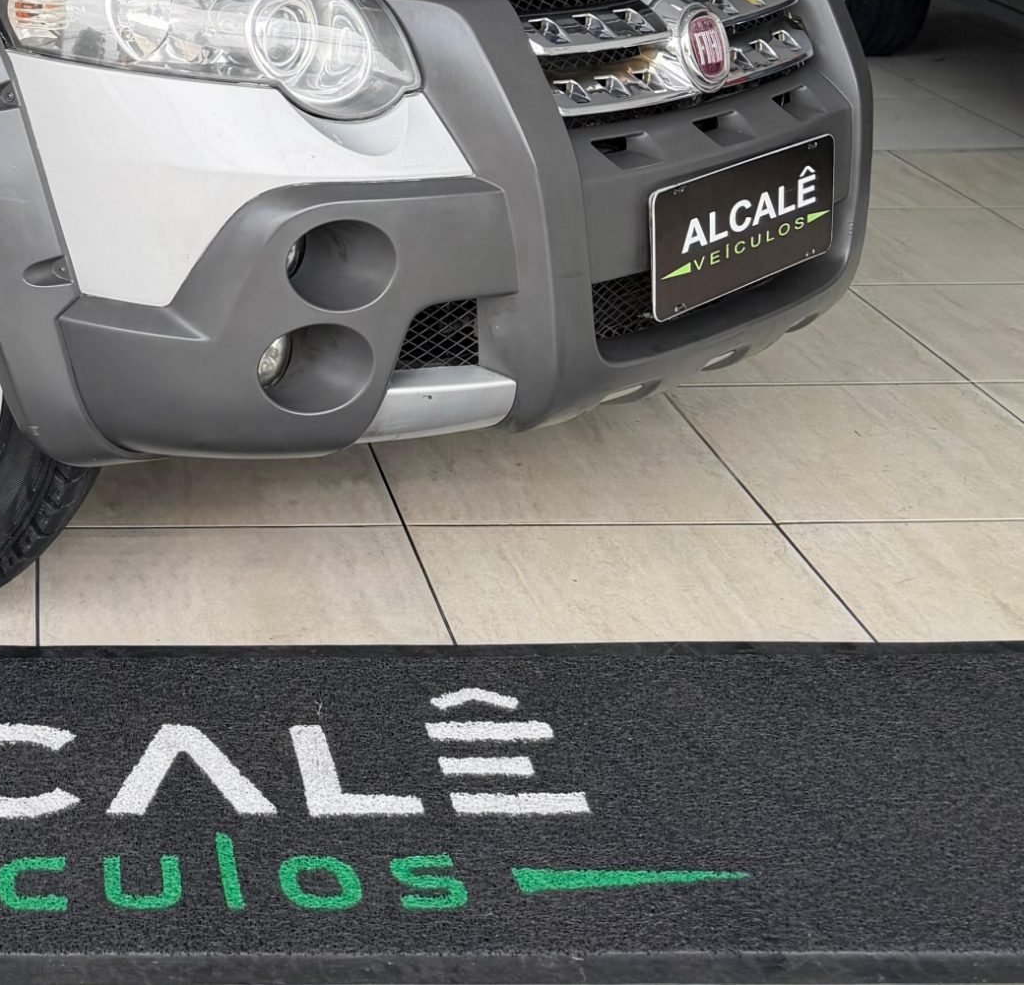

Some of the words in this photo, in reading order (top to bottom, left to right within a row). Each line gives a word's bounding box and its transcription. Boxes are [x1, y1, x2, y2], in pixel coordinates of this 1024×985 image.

[694, 29, 723, 66] FIAT
[681, 165, 817, 255] ALCALÊ
[693, 216, 806, 271] VEÍCULOS
